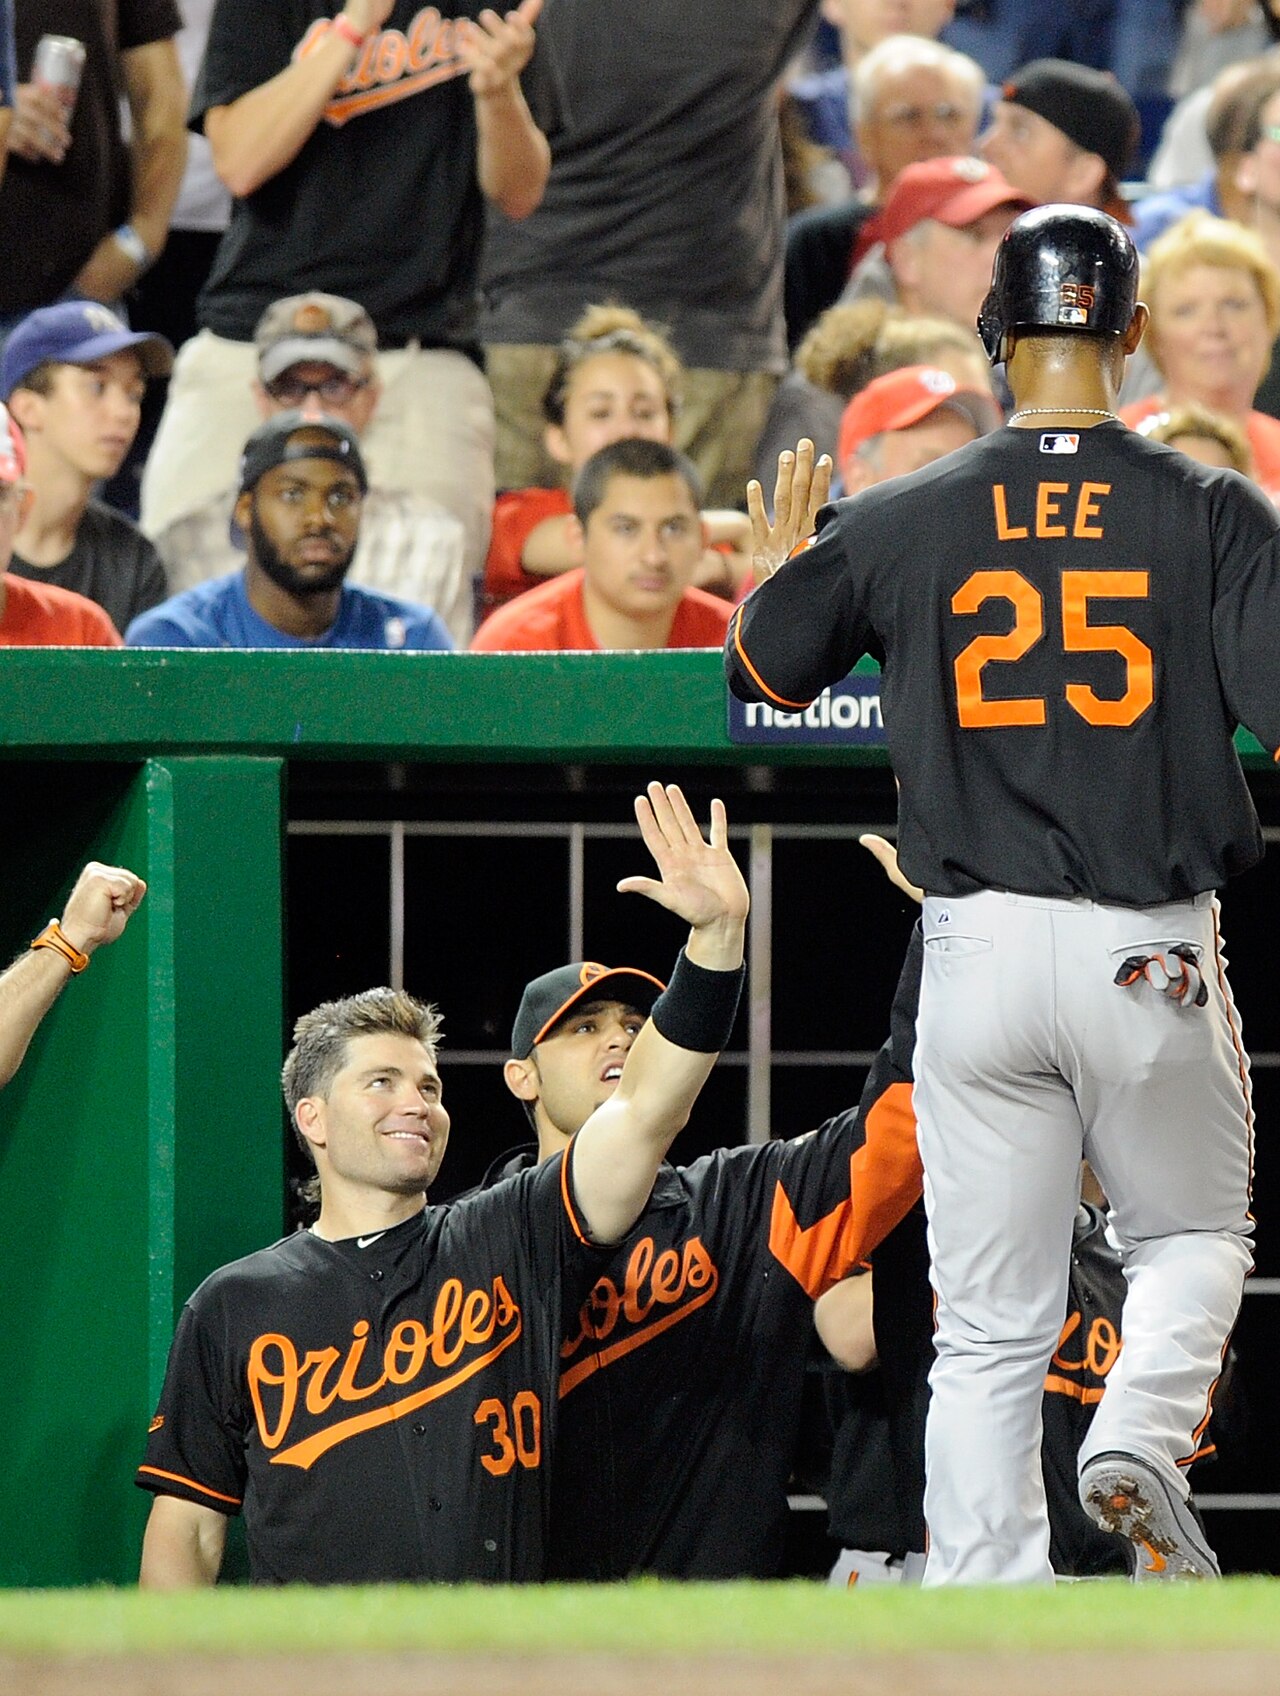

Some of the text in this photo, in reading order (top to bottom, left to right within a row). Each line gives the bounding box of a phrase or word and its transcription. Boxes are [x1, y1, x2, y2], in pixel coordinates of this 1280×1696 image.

[993, 482, 1111, 541] LEE
[951, 570, 1154, 728] 25
[247, 1276, 523, 1449] Orioles
[473, 1390, 542, 1475] 30
